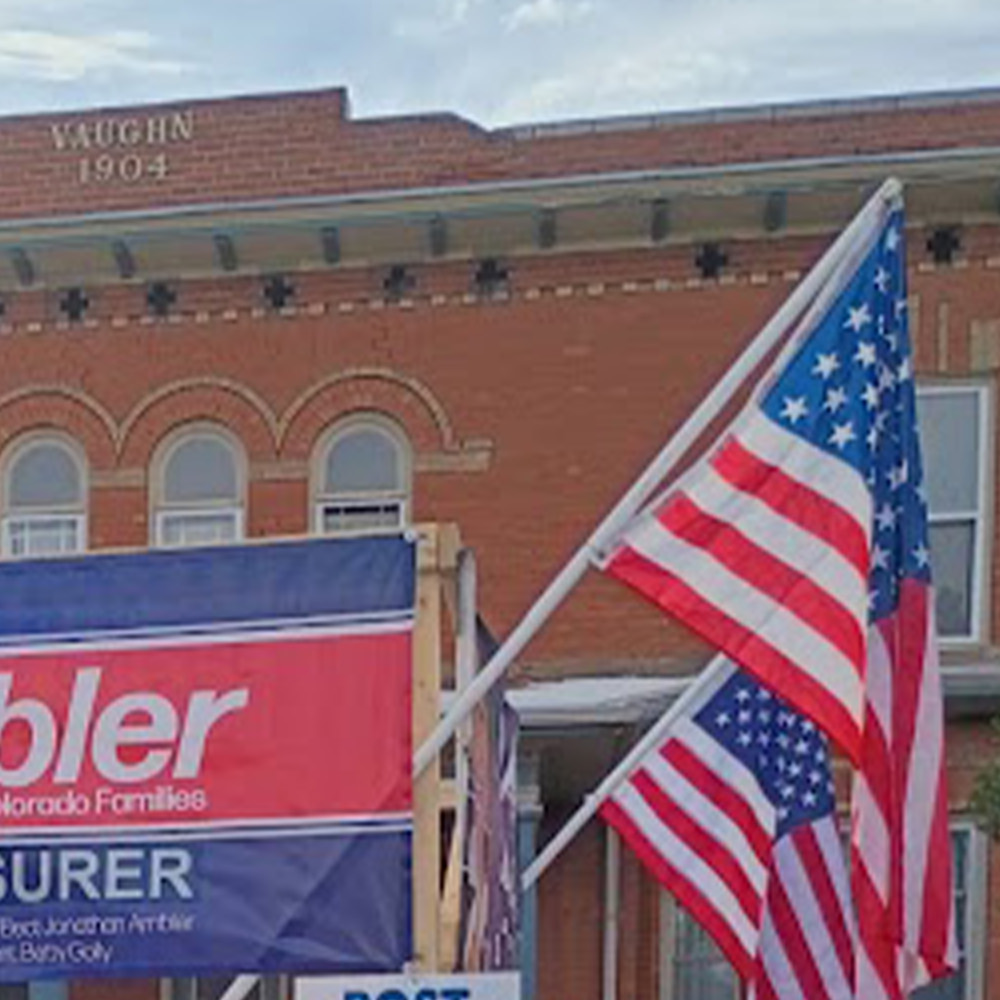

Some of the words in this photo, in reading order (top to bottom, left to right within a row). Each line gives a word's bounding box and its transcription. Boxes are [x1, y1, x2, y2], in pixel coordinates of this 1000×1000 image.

[51, 111, 194, 150] VAUGHN
[80, 153, 168, 184] 1904
[95, 786, 207, 813] Families
